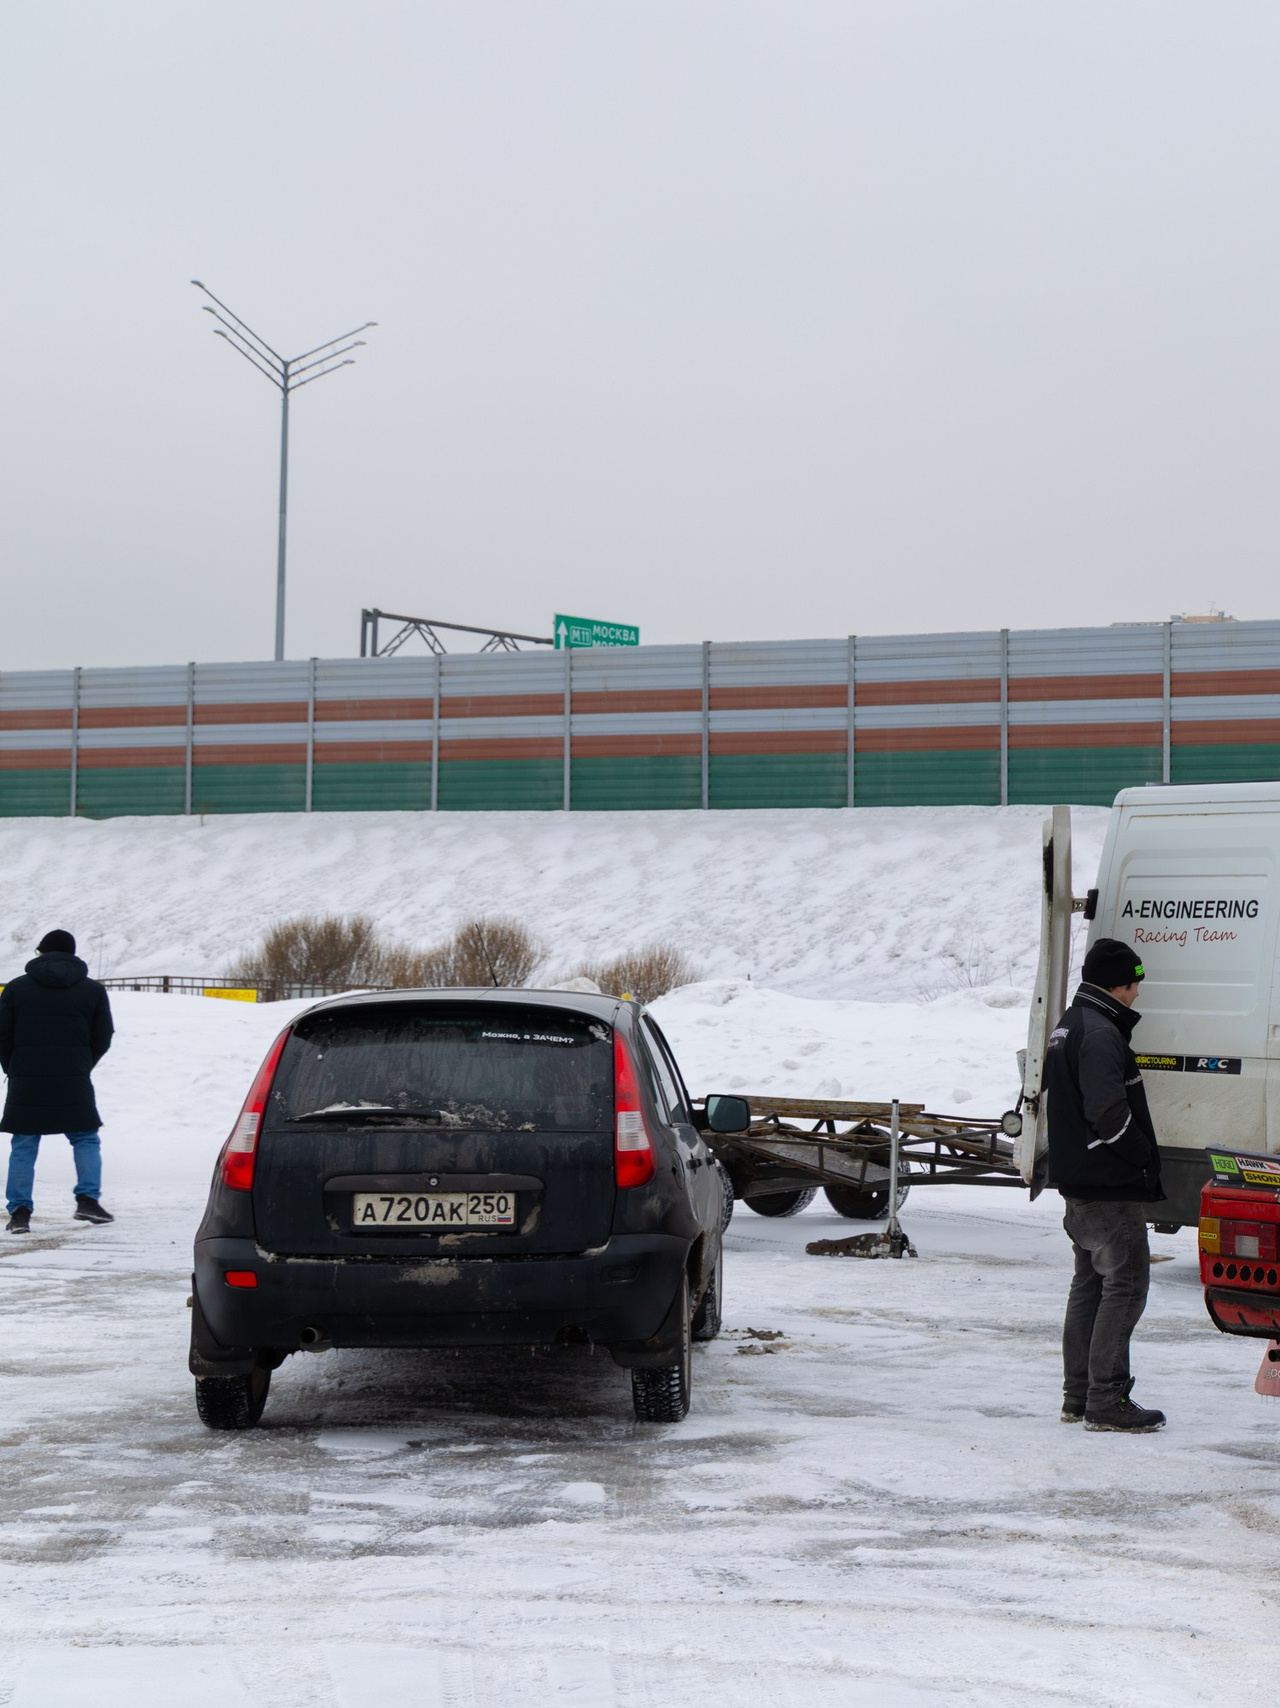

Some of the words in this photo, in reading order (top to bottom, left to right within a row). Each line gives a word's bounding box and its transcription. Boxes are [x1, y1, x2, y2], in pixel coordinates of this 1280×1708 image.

[592, 624, 636, 642] МОСКВА
[1121, 900, 1259, 919] A-ENGINEERING
[1134, 926, 1188, 947] Racing
[1193, 926, 1237, 942] Team
[482, 1031, 521, 1040] Можно,
[533, 1034, 574, 1044] ЗАЧЕМ?
[1214, 1158, 1235, 1170] HOGO
[1237, 1157, 1267, 1169] HAWK
[361, 1197, 463, 1222] А720АК
[469, 1195, 509, 1214] 250
[478, 1214, 497, 1222] RUS
